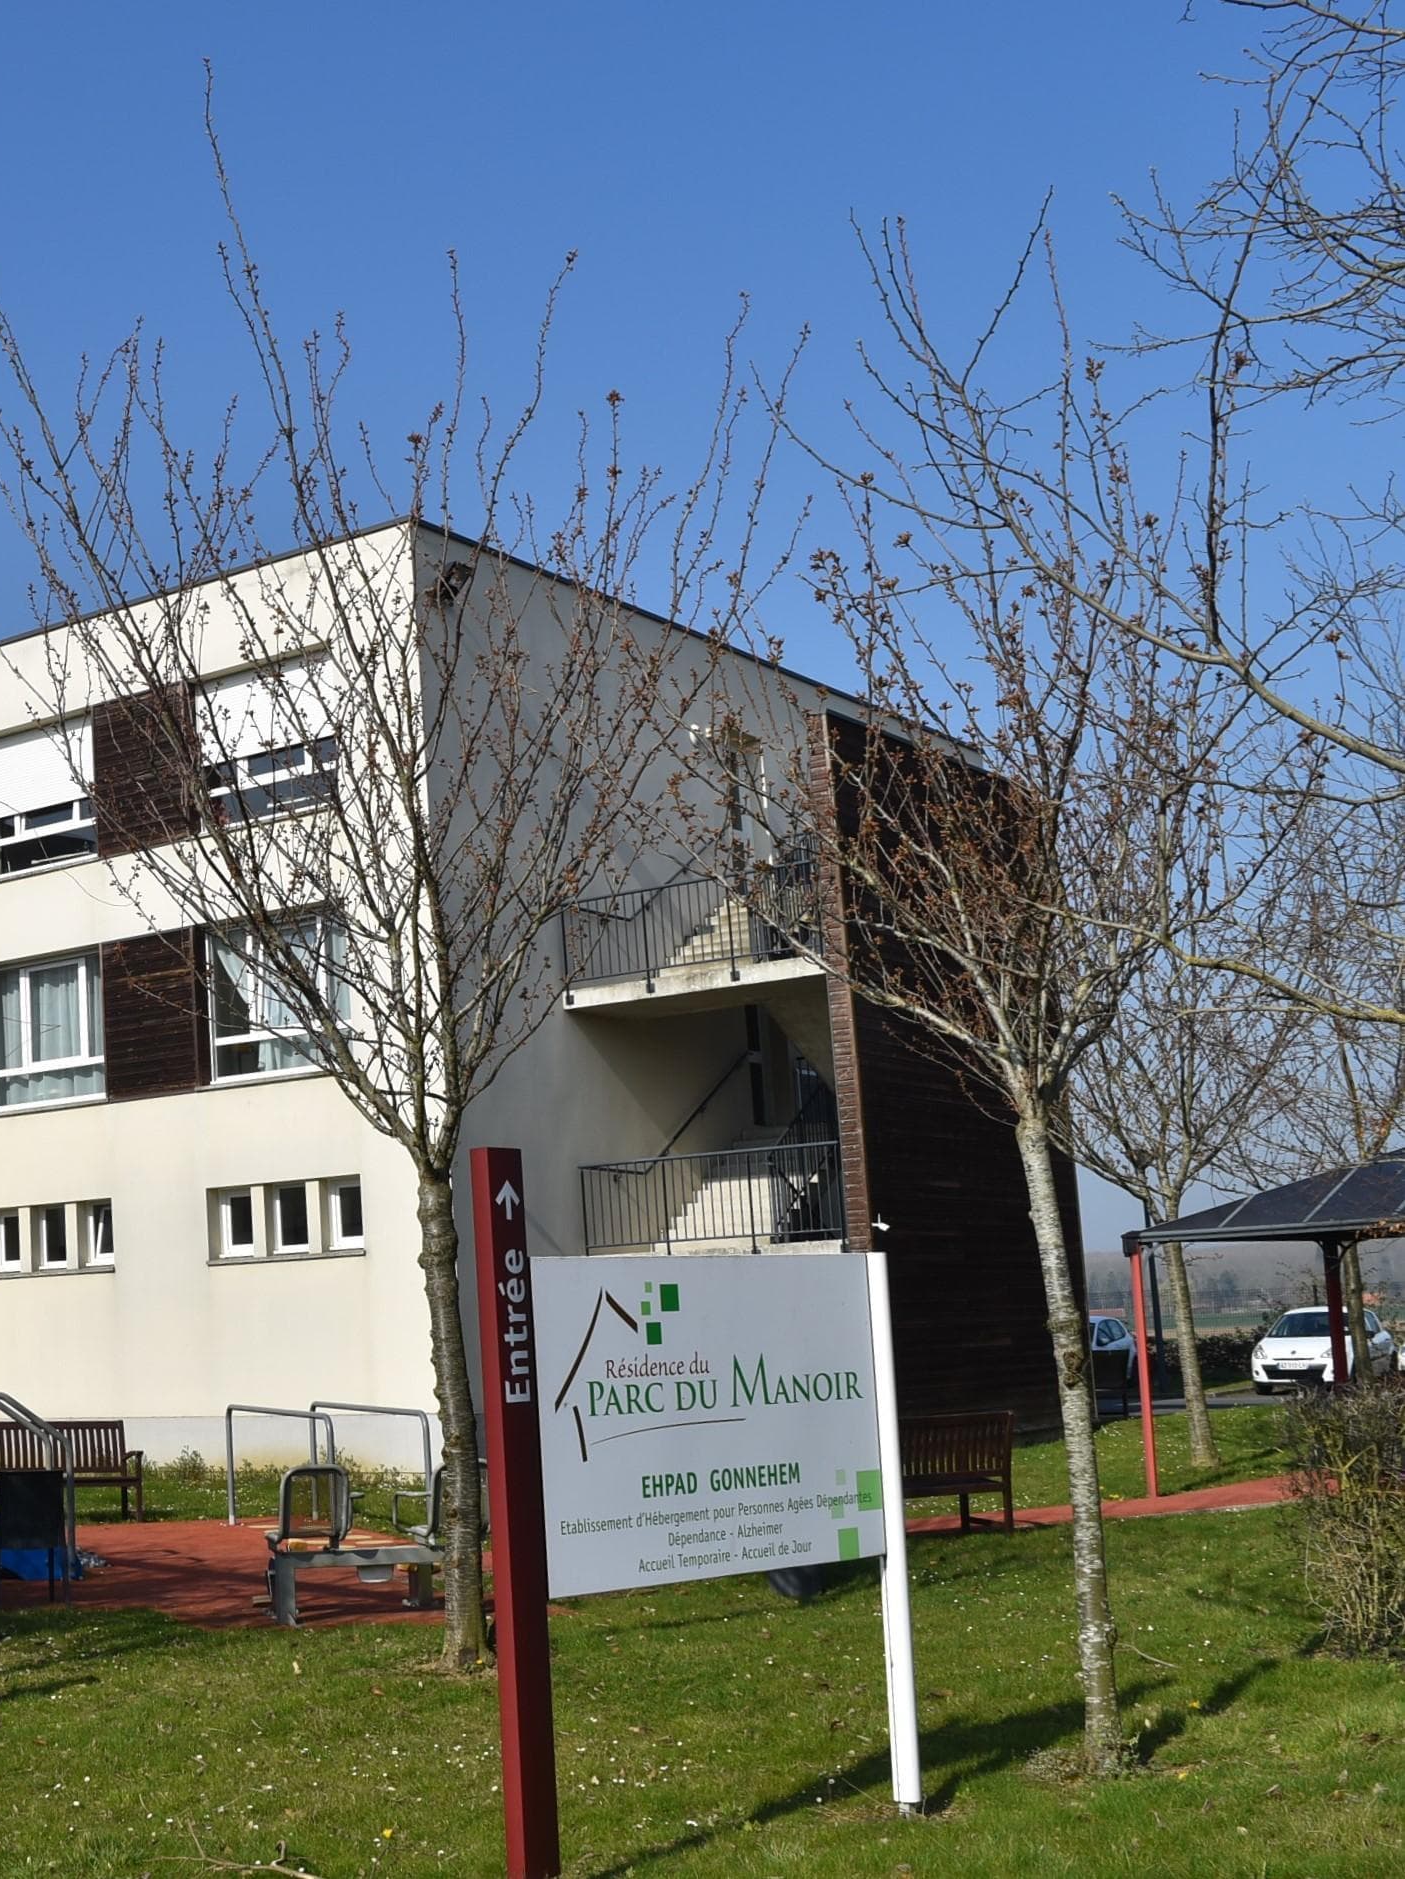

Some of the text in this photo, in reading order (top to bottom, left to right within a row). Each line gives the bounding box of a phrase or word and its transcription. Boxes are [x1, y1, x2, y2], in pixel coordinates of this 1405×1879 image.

[498, 1248, 531, 1403] Entrée
[606, 1351, 710, 1379] Résidence du
[586, 1352, 864, 1417] PARC DU MANOIR
[642, 1462, 800, 1498] EHPAD GONNEHEM
[560, 1515, 633, 1535] Etablissement
[713, 1506, 735, 1522] pour
[738, 1499, 785, 1516] Personnes
[787, 1496, 814, 1514] Agées
[816, 1491, 873, 1510] Dépendantes
[668, 1528, 727, 1548] Dépendance
[737, 1521, 783, 1538] Alzheimer
[638, 1555, 676, 1573] Accueil
[678, 1549, 731, 1569] Temporaire
[741, 1543, 775, 1560] Accueil
[778, 1543, 790, 1556] de
[791, 1540, 812, 1555] Jour
